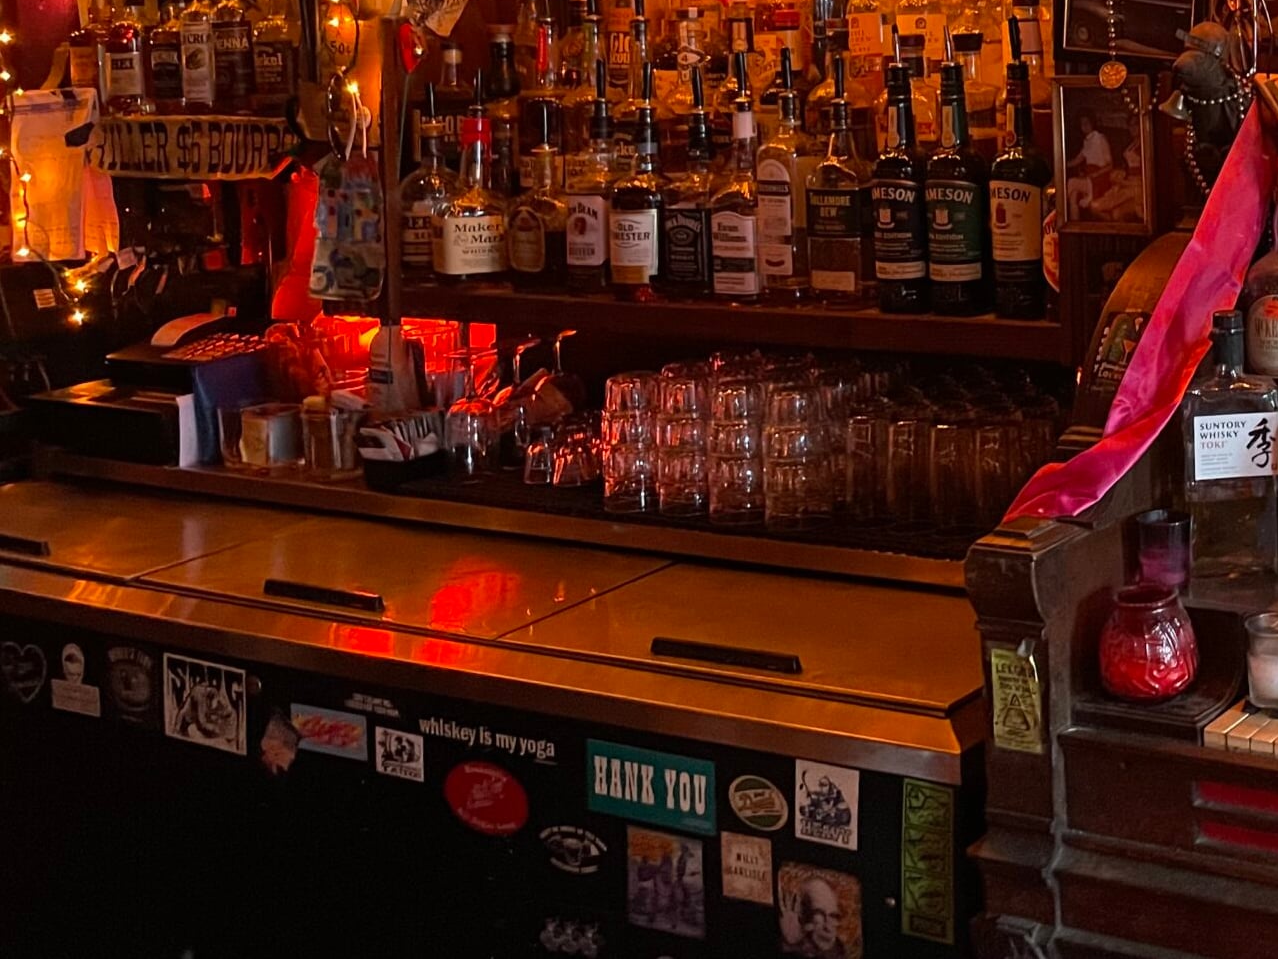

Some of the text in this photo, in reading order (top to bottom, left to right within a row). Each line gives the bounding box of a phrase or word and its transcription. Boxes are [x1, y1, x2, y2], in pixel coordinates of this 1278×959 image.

[924, 186, 974, 204] AMESON
[1200, 420, 1247, 431] SUNTORY
[1200, 430, 1239, 441] WHISKY
[1246, 418, 1275, 469] 季
[1200, 440, 1225, 450] TOKI
[418, 717, 556, 760] whiskey is my yoga
[594, 754, 708, 817] HANK YOU
